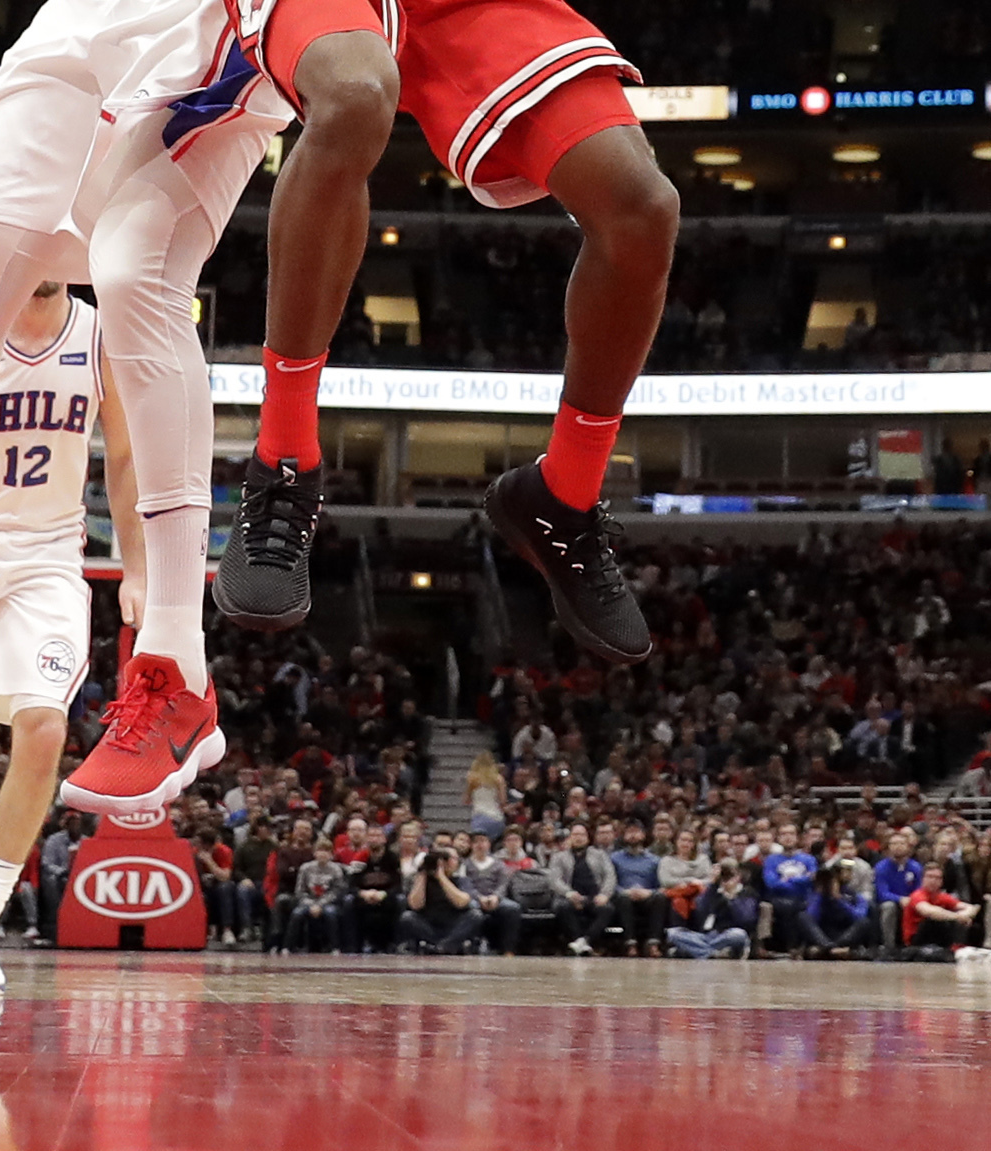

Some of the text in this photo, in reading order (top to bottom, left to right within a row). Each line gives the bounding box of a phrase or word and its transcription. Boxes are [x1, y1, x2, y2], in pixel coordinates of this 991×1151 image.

[835, 90, 915, 108] HARRIS
[918, 89, 975, 105] CLUB
[319, 373, 373, 396] with
[384, 381, 441, 405] your
[451, 378, 509, 401] BMO
[678, 380, 746, 404] Debit
[757, 377, 907, 403] MasterCard
[3, 445, 52, 488] 12
[95, 870, 174, 906] KIA
